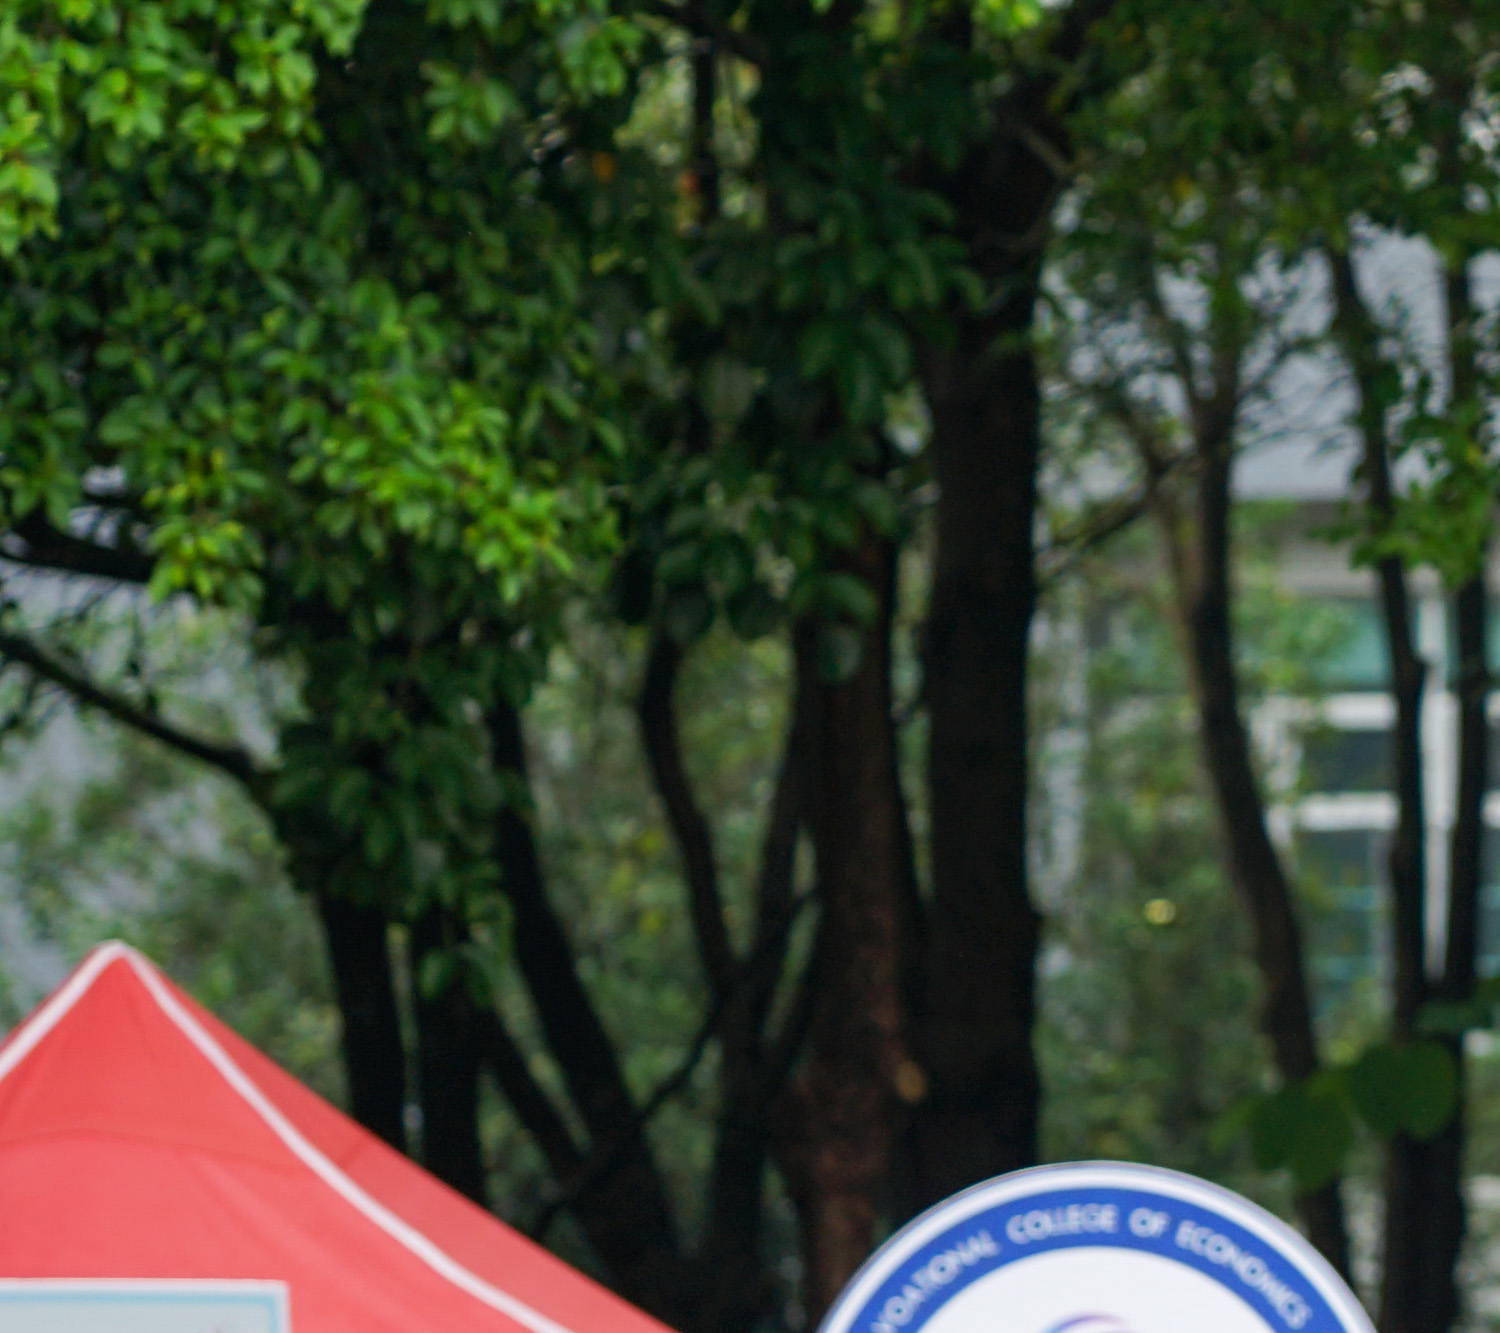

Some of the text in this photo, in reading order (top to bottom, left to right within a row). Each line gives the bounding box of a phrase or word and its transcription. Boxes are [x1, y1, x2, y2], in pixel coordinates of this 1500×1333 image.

[1005, 1203, 1120, 1246] COLLEGE
[1128, 1206, 1172, 1240] OF
[1175, 1219, 1314, 1331] ECONOMICS
